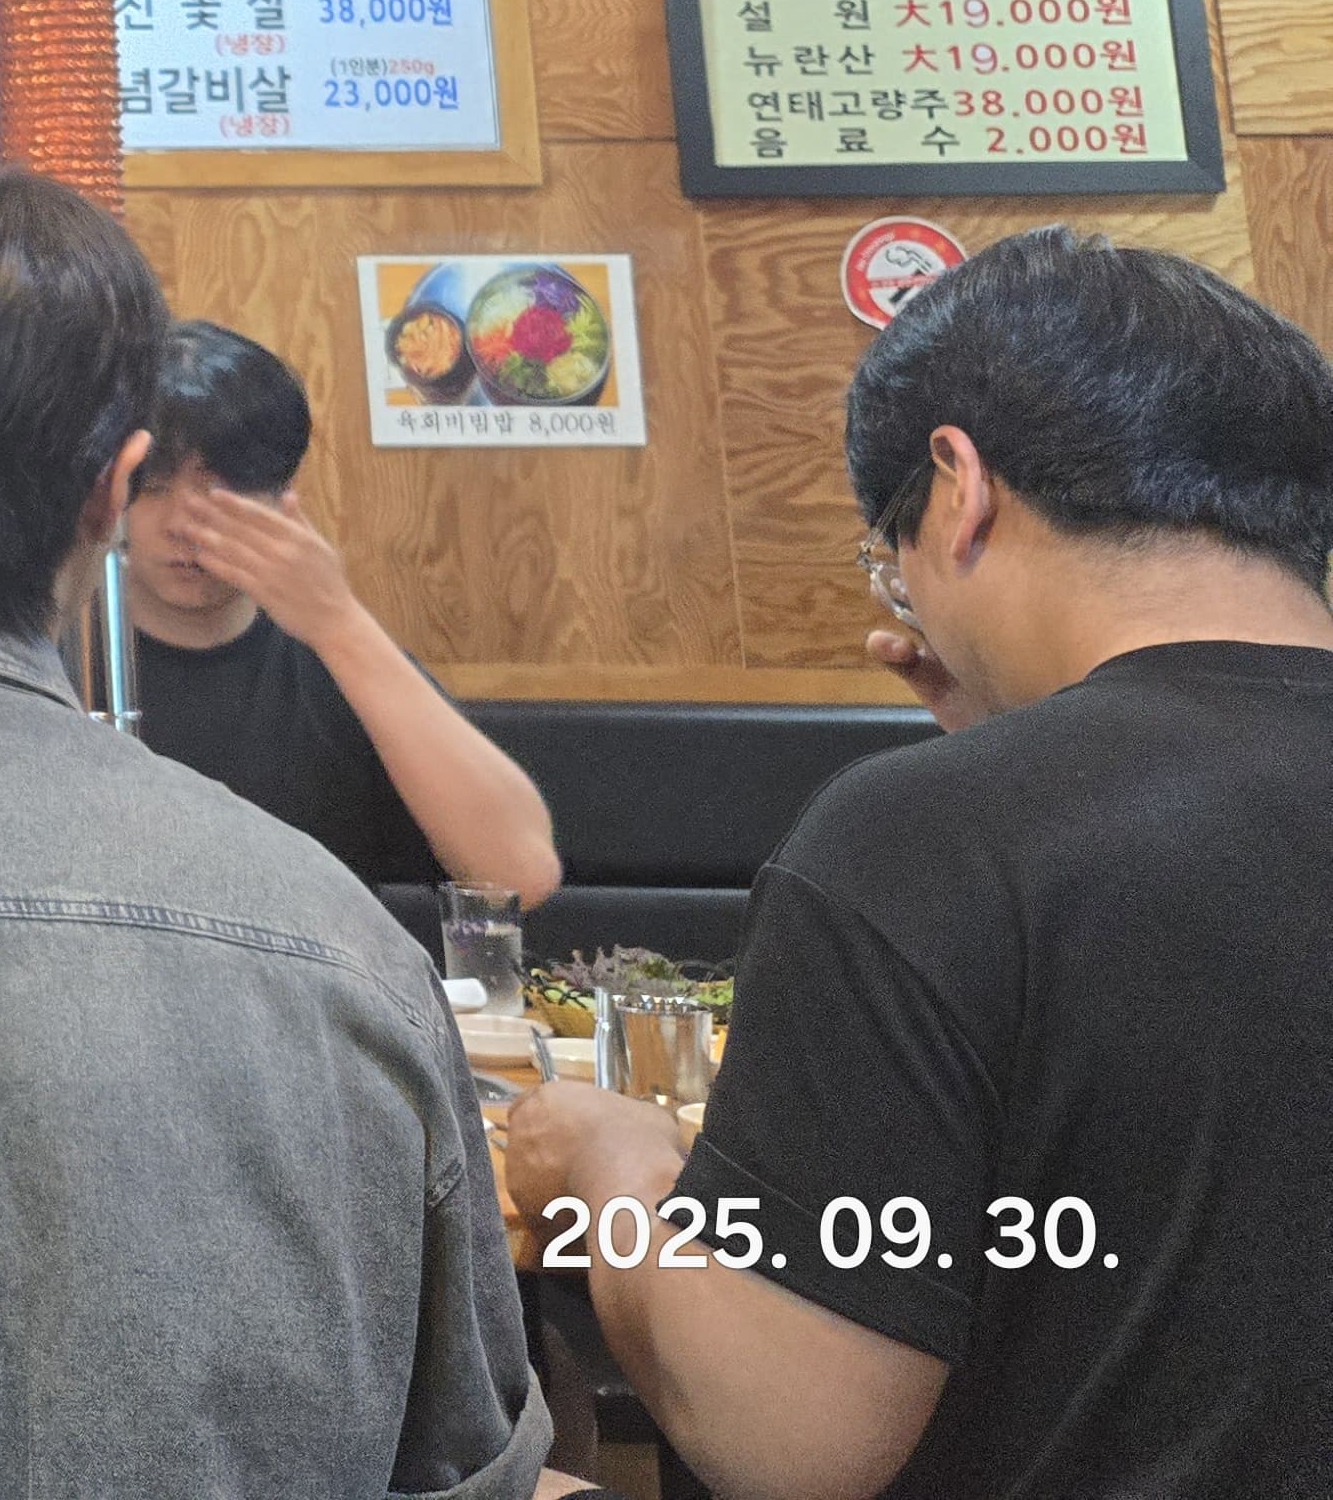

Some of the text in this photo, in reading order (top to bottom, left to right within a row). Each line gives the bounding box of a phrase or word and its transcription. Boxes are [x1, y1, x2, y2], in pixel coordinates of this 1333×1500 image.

[119, 66, 459, 115] 념갈비살 23,000원
[748, 85, 1145, 123] 연태고량주 38.000원
[750, 122, 1150, 159] 음료수 2.000원
